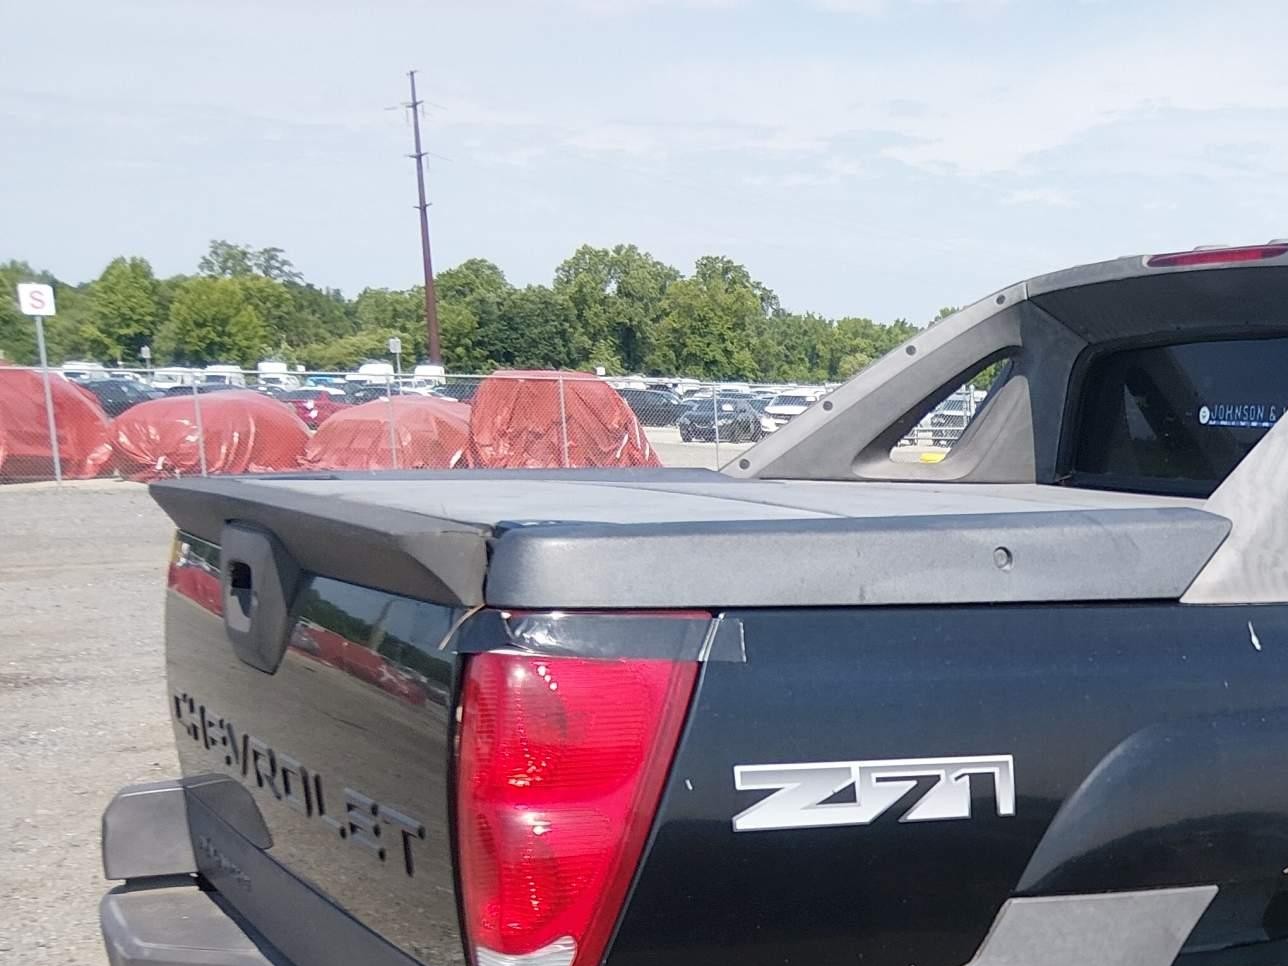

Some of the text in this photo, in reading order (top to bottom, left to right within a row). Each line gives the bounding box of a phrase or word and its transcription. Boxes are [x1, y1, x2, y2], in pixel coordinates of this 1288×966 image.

[30, 290, 46, 310] S
[1212, 405, 1265, 420] JOHNSON
[1269, 406, 1277, 421] &
[173, 689, 426, 878] CHEVROLET
[732, 754, 1016, 833] Z71
